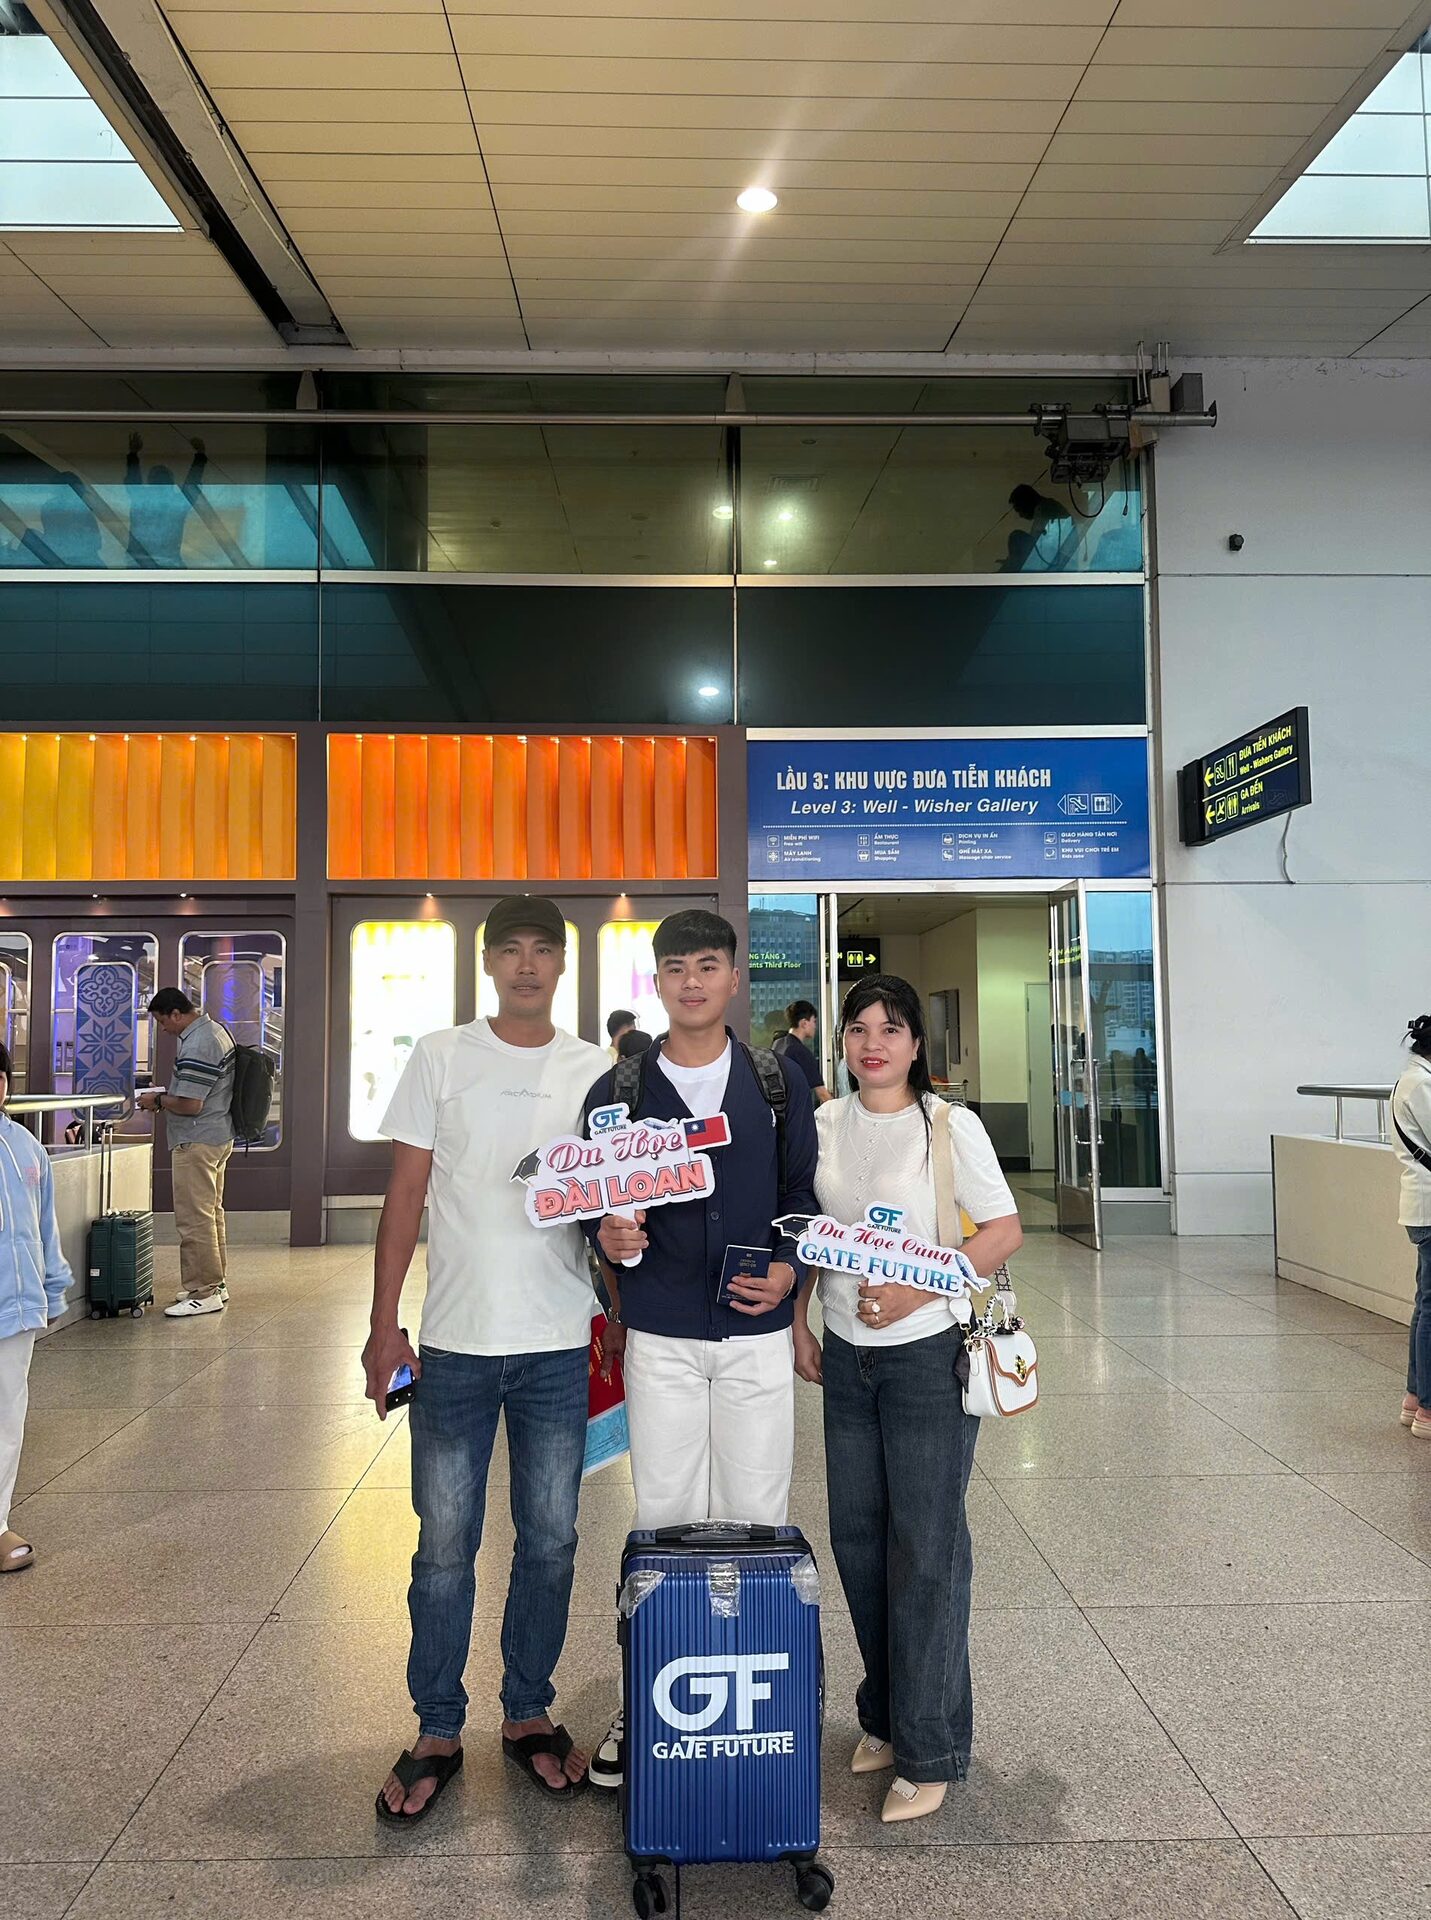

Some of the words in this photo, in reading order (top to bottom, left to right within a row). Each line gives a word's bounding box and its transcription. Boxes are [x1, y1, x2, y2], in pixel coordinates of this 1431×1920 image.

[1239, 745, 1252, 761] ĐƯA
[1268, 725, 1292, 747] KHÁCH
[1239, 763, 1250, 775] Well
[1253, 754, 1273, 769] Wishers
[1273, 744, 1293, 760] Gallery
[776, 765, 808, 790] LẦU
[812, 771, 829, 790] 3:
[834, 771, 868, 790] KHU
[873, 769, 907, 793] VỰC
[912, 768, 947, 789] ĐƯA
[952, 763, 989, 788] TIỄN
[995, 765, 1051, 788] KHÁCH
[1240, 787, 1249, 800] GA
[1249, 778, 1263, 797] ĐẾN
[791, 800, 837, 814] Level
[841, 800, 856, 814] 3:
[863, 800, 897, 813] Well
[914, 798, 972, 813] Wisher
[977, 798, 1039, 815] Gallery
[1241, 801, 1260, 815] Arrivals
[592, 1107, 623, 1128] GF
[546, 1142, 604, 1173] Du
[611, 1128, 684, 1161] Học
[534, 1177, 603, 1221] ĐÀI
[606, 1160, 707, 1208] LOAN
[869, 1206, 903, 1226] GF
[813, 1219, 844, 1240] Du
[853, 1227, 895, 1250] Học
[901, 1238, 954, 1265] Cùng
[801, 1242, 861, 1271] GATE
[867, 1255, 960, 1292] FUTURE
[652, 1652, 790, 1732] GF
[652, 1735, 708, 1760] GATE
[712, 1736, 794, 1758] FUTURE
